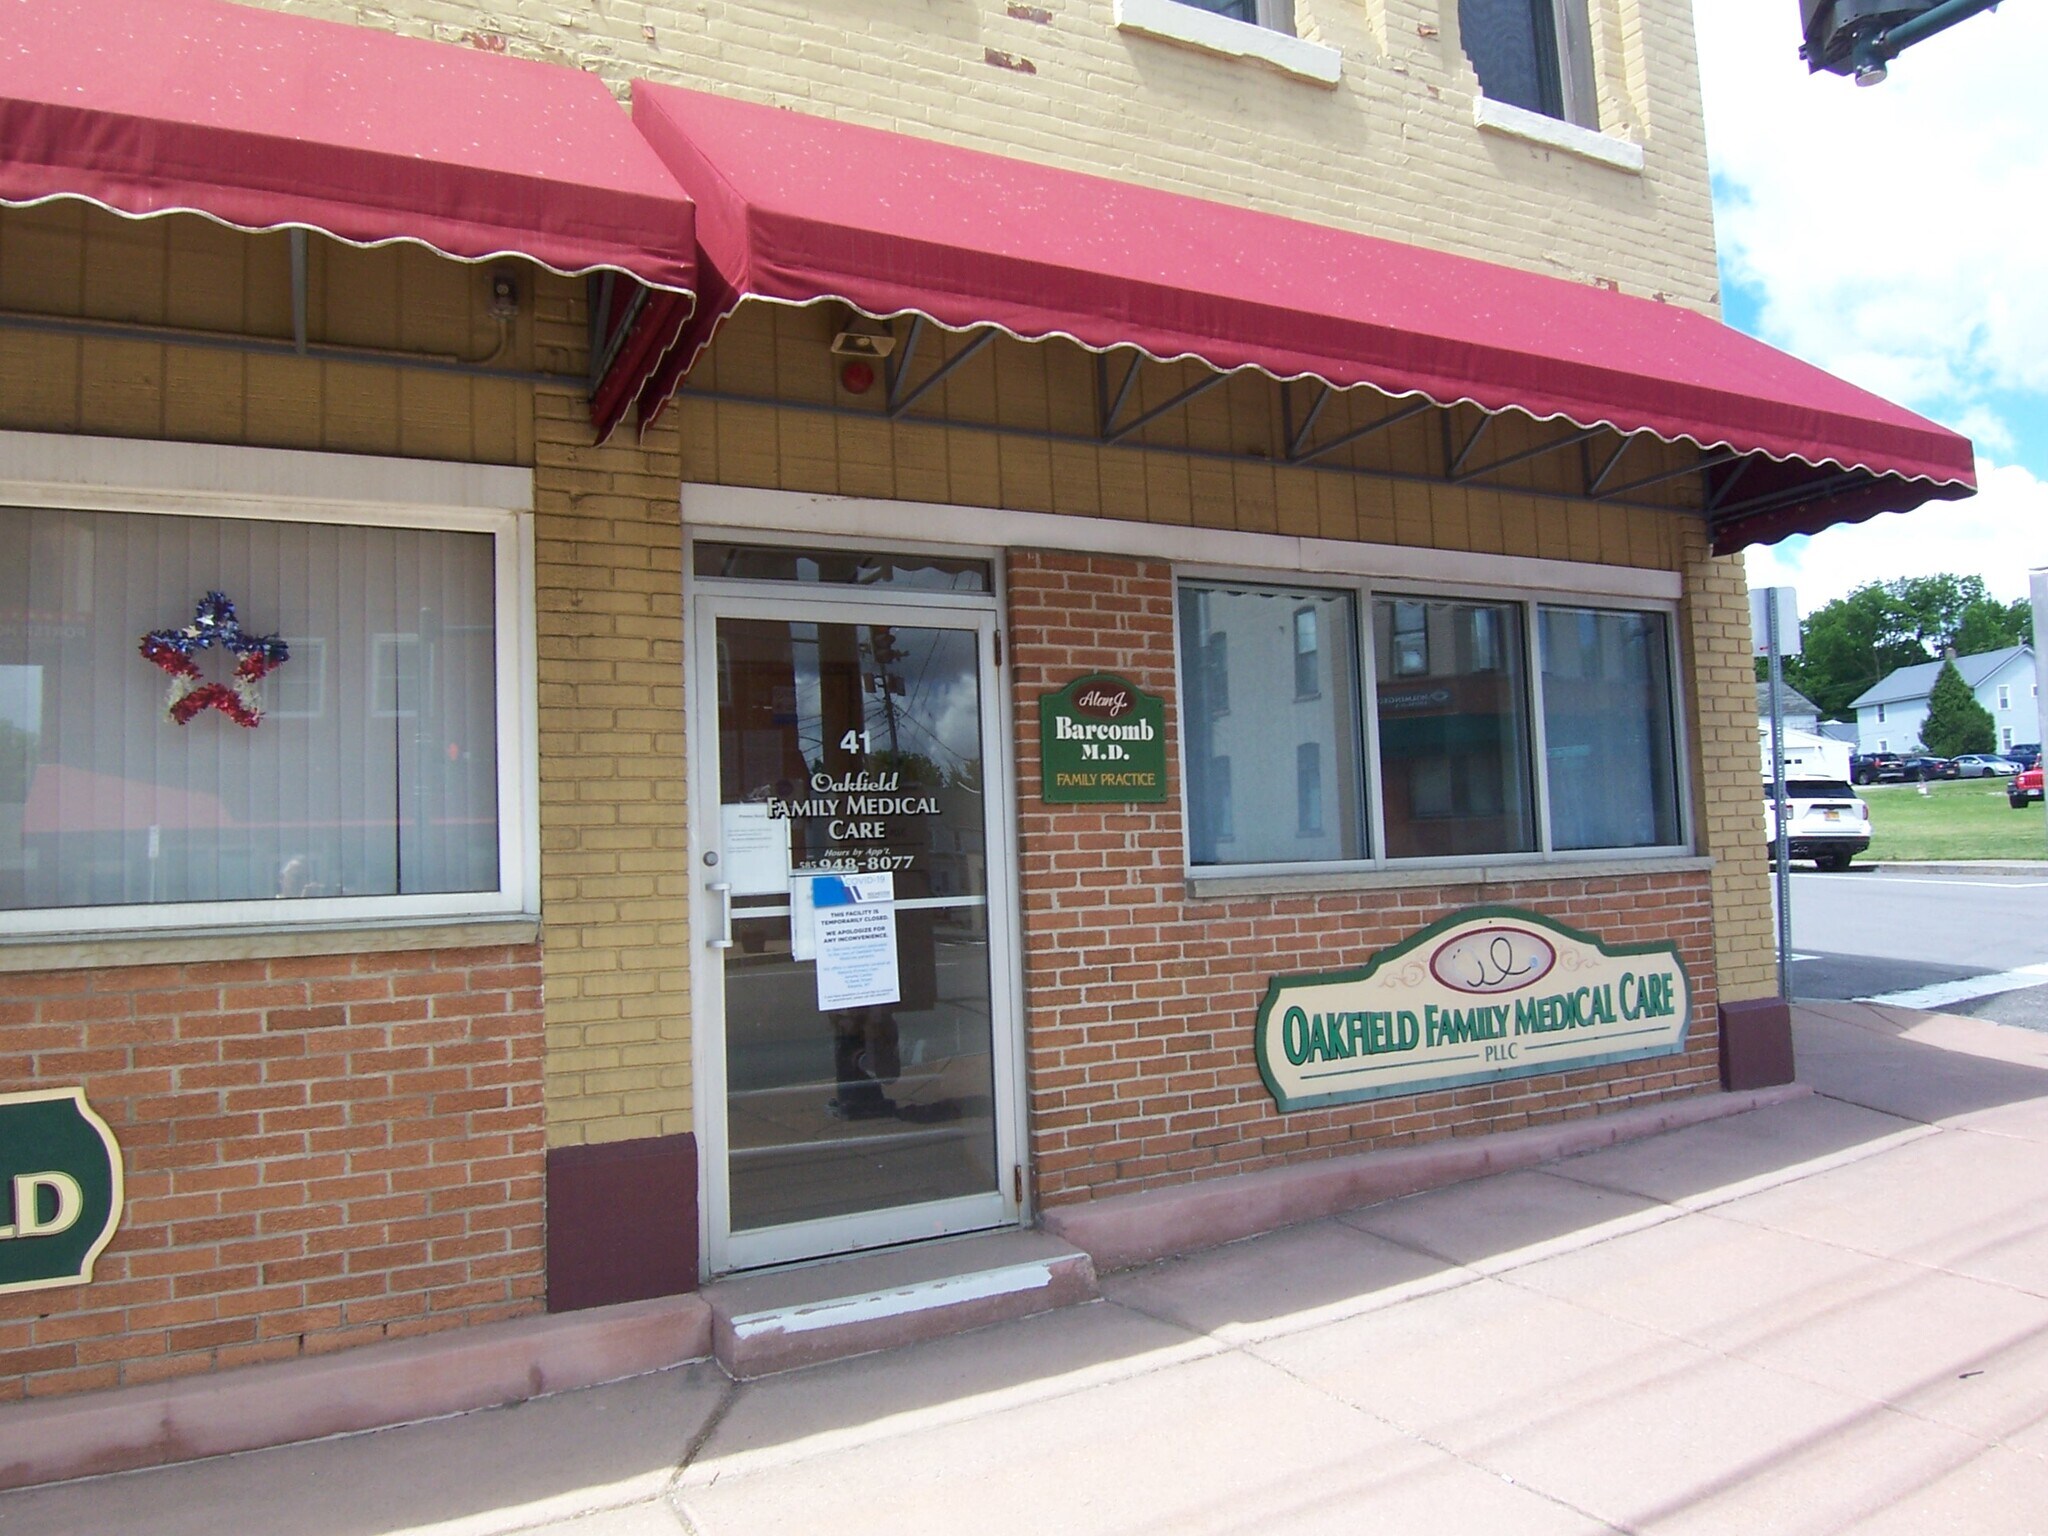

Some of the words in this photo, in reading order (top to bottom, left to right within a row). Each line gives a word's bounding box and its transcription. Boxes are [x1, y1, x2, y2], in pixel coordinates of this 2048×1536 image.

[1079, 690, 1114, 707] Alan
[1110, 691, 1128, 717] J.
[1055, 716, 1155, 741] Barcomb
[839, 730, 871, 754] 41
[1081, 744, 1130, 760] M.D.
[811, 772, 899, 793] Oakfield
[1057, 773, 1098, 786] FAMILY
[1101, 773, 1156, 786] PRACTICE
[767, 797, 839, 819] FAMILY
[846, 796, 941, 816] MEDICAL
[828, 820, 886, 840] CARE
[824, 848, 850, 857] Hours
[852, 848, 863, 857] by
[818, 855, 915, 871] 948-8077
[845, 875, 886, 886] COVID-19
[821, 917, 863, 926] TEMPORARILY
[846, 909, 872, 917] FACILITY
[1282, 1005, 1420, 1066] OAKFIELD
[1424, 1003, 1510, 1048] FAMILY
[1514, 984, 1616, 1036] MEDICAL
[1618, 972, 1676, 1021] CARE
[1484, 1042, 1519, 1063] PLLC
